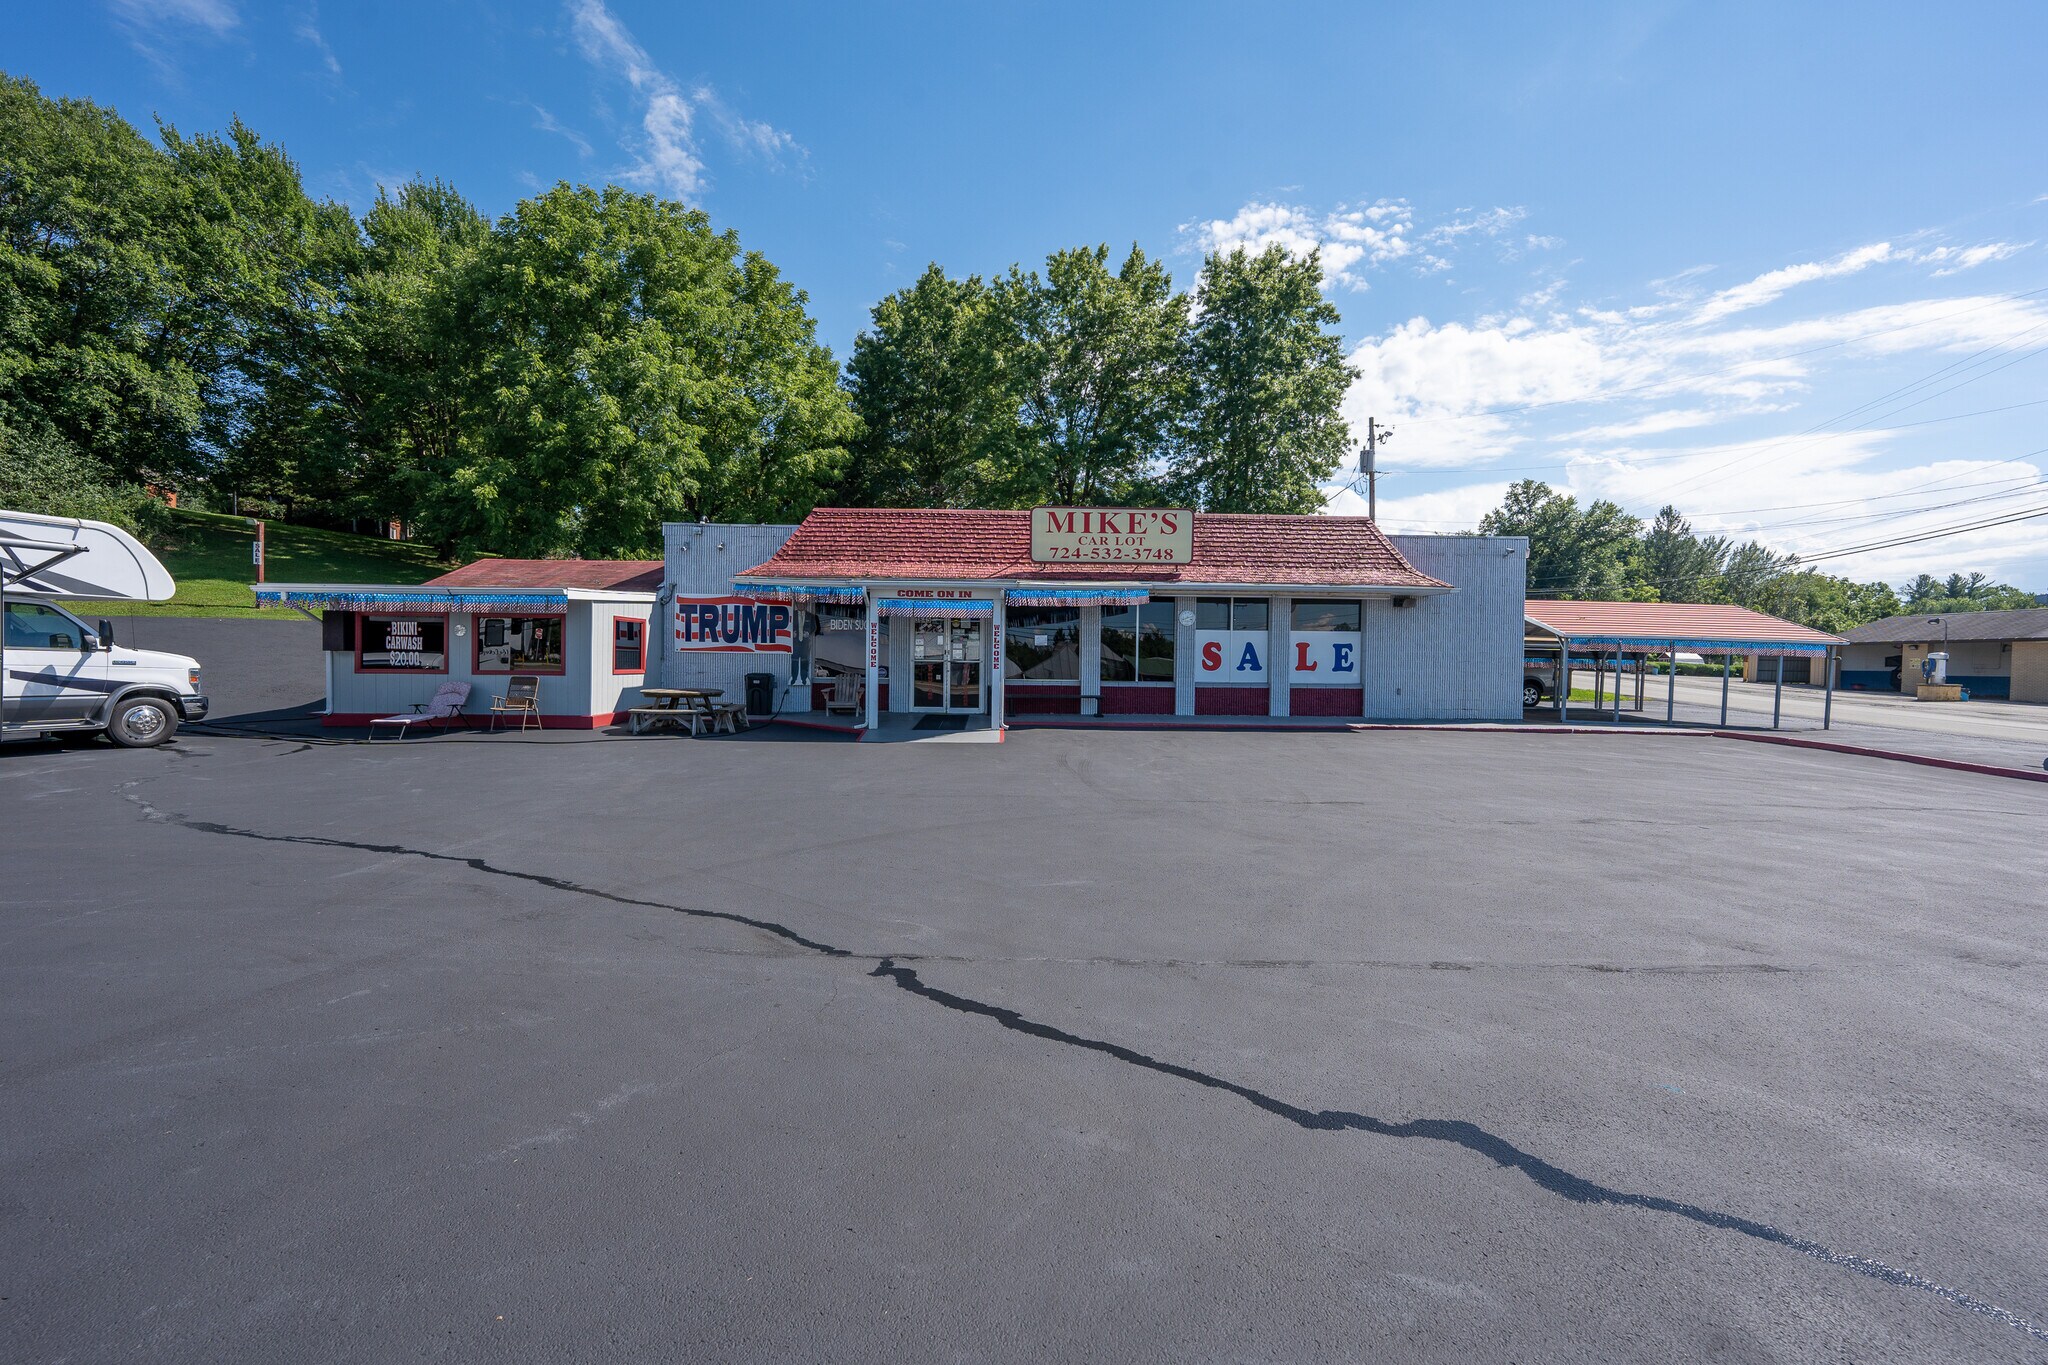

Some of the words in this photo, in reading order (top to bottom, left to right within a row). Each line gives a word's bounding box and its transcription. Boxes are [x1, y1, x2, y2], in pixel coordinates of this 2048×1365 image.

[1045, 511, 1178, 535] MIKE'S
[1078, 536, 1108, 546] CAR
[1115, 536, 1146, 546] LOT
[1050, 547, 1174, 560] 724-532-3748
[897, 589, 934, 598] COME
[937, 590, 955, 598] ON
[958, 590, 973, 598] IN
[391, 621, 418, 636] BIKINI
[679, 604, 790, 643] TRUMP
[830, 619, 853, 630] BIDEN
[385, 635, 423, 650] CARWASH
[389, 650, 421, 666] $20.00
